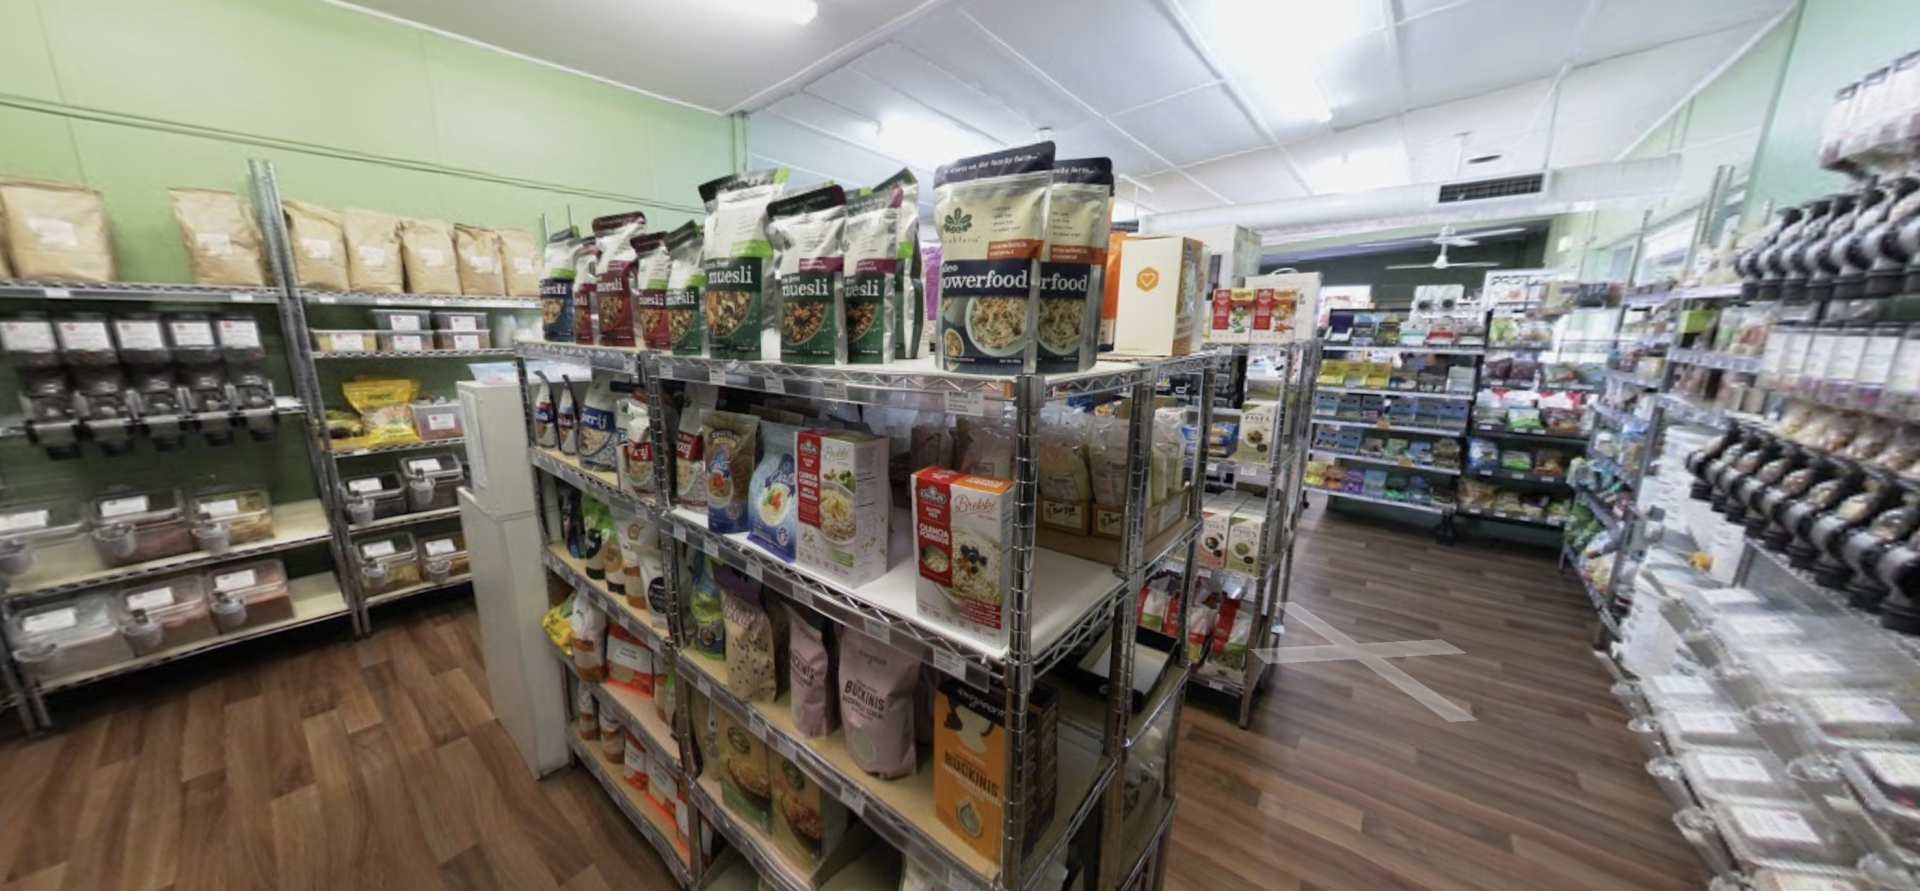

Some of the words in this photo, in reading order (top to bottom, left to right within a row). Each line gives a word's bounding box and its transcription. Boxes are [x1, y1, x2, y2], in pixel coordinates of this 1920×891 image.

[708, 265, 753, 285] muesli
[944, 270, 1029, 289] owerfood
[1040, 273, 1088, 292] rfood
[954, 494, 998, 513] Brekki
[920, 523, 948, 537] QUINOA
[844, 680, 884, 711] BUCKINIS
[944, 750, 999, 798] BUCKINIS
